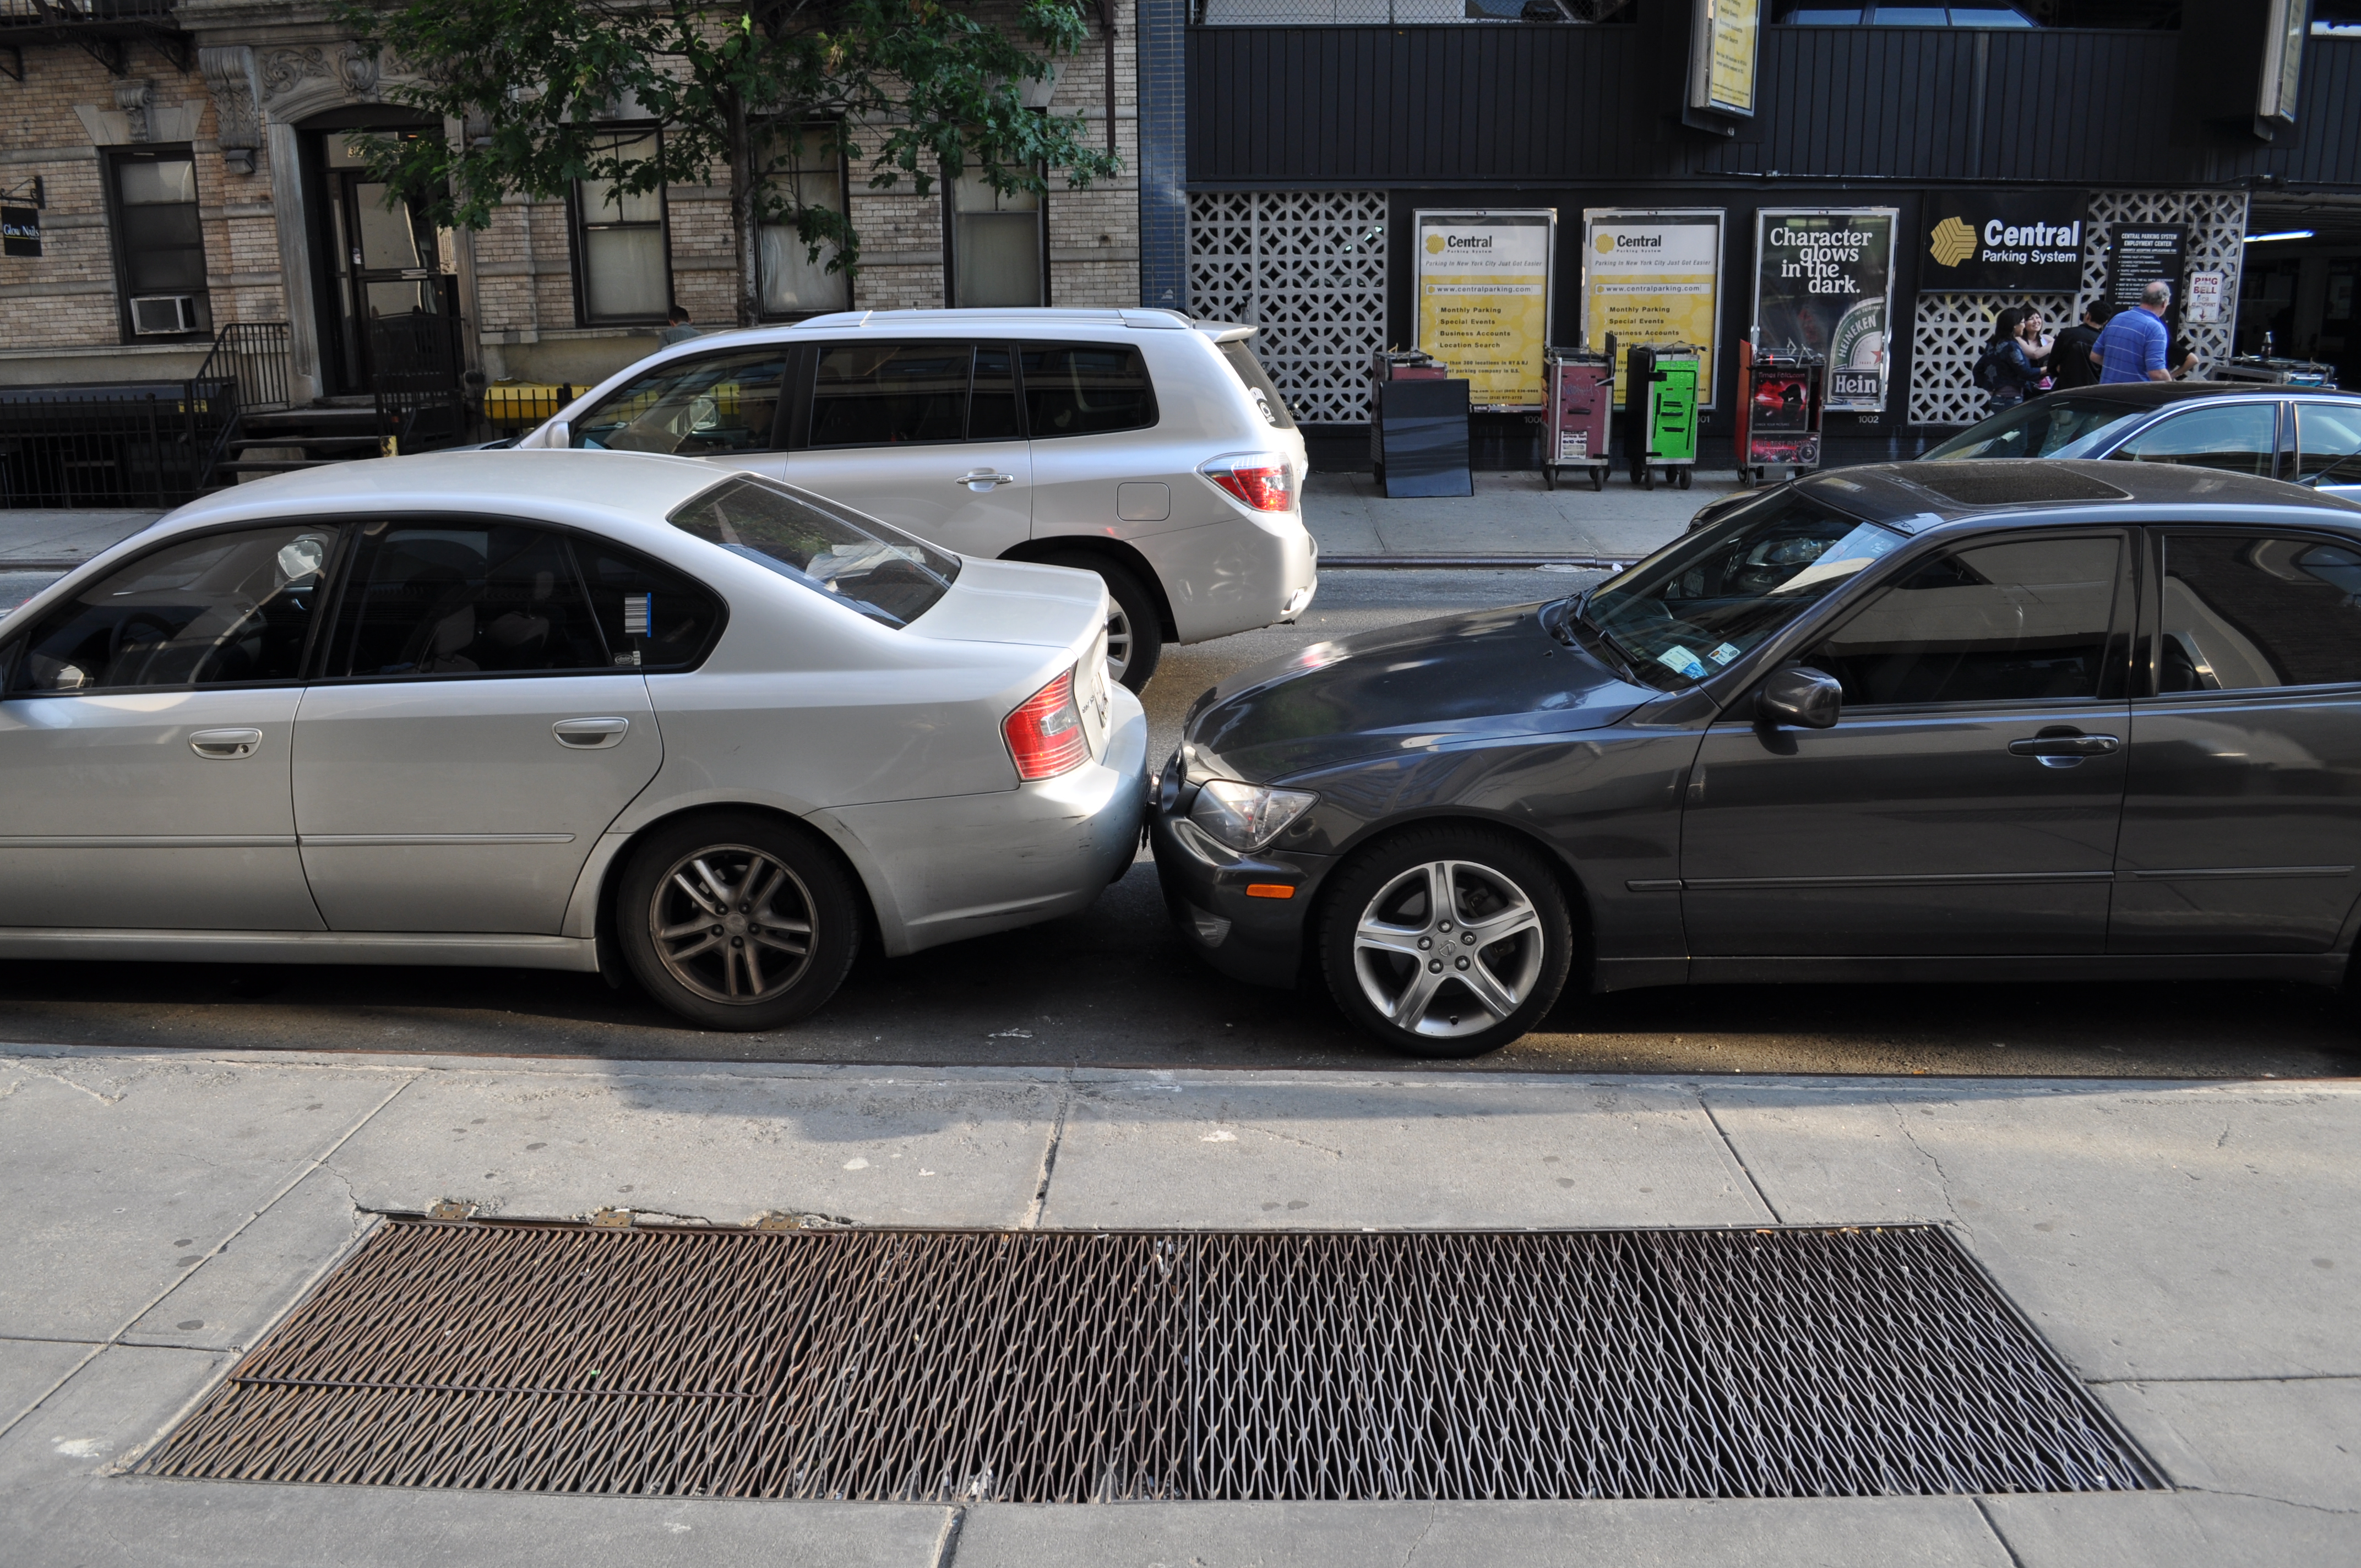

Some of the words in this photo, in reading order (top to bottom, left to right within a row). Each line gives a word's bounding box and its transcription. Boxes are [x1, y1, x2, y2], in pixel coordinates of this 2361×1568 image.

[4, 224, 21, 236] Glow
[22, 226, 40, 237] Nails
[1771, 227, 1873, 246] Character
[1984, 220, 2079, 246] Central
[1448, 235, 1492, 247] Central
[1617, 235, 1661, 247] Central
[1800, 244, 1859, 266] glows
[1983, 250, 2027, 264] Parking
[2031, 250, 2076, 264] System
[1781, 259, 1801, 277] in
[1807, 260, 1840, 277] the
[1808, 275, 1860, 293] dark.
[1838, 314, 1877, 358] HEINEKEN
[1835, 374, 1878, 393] Hein
